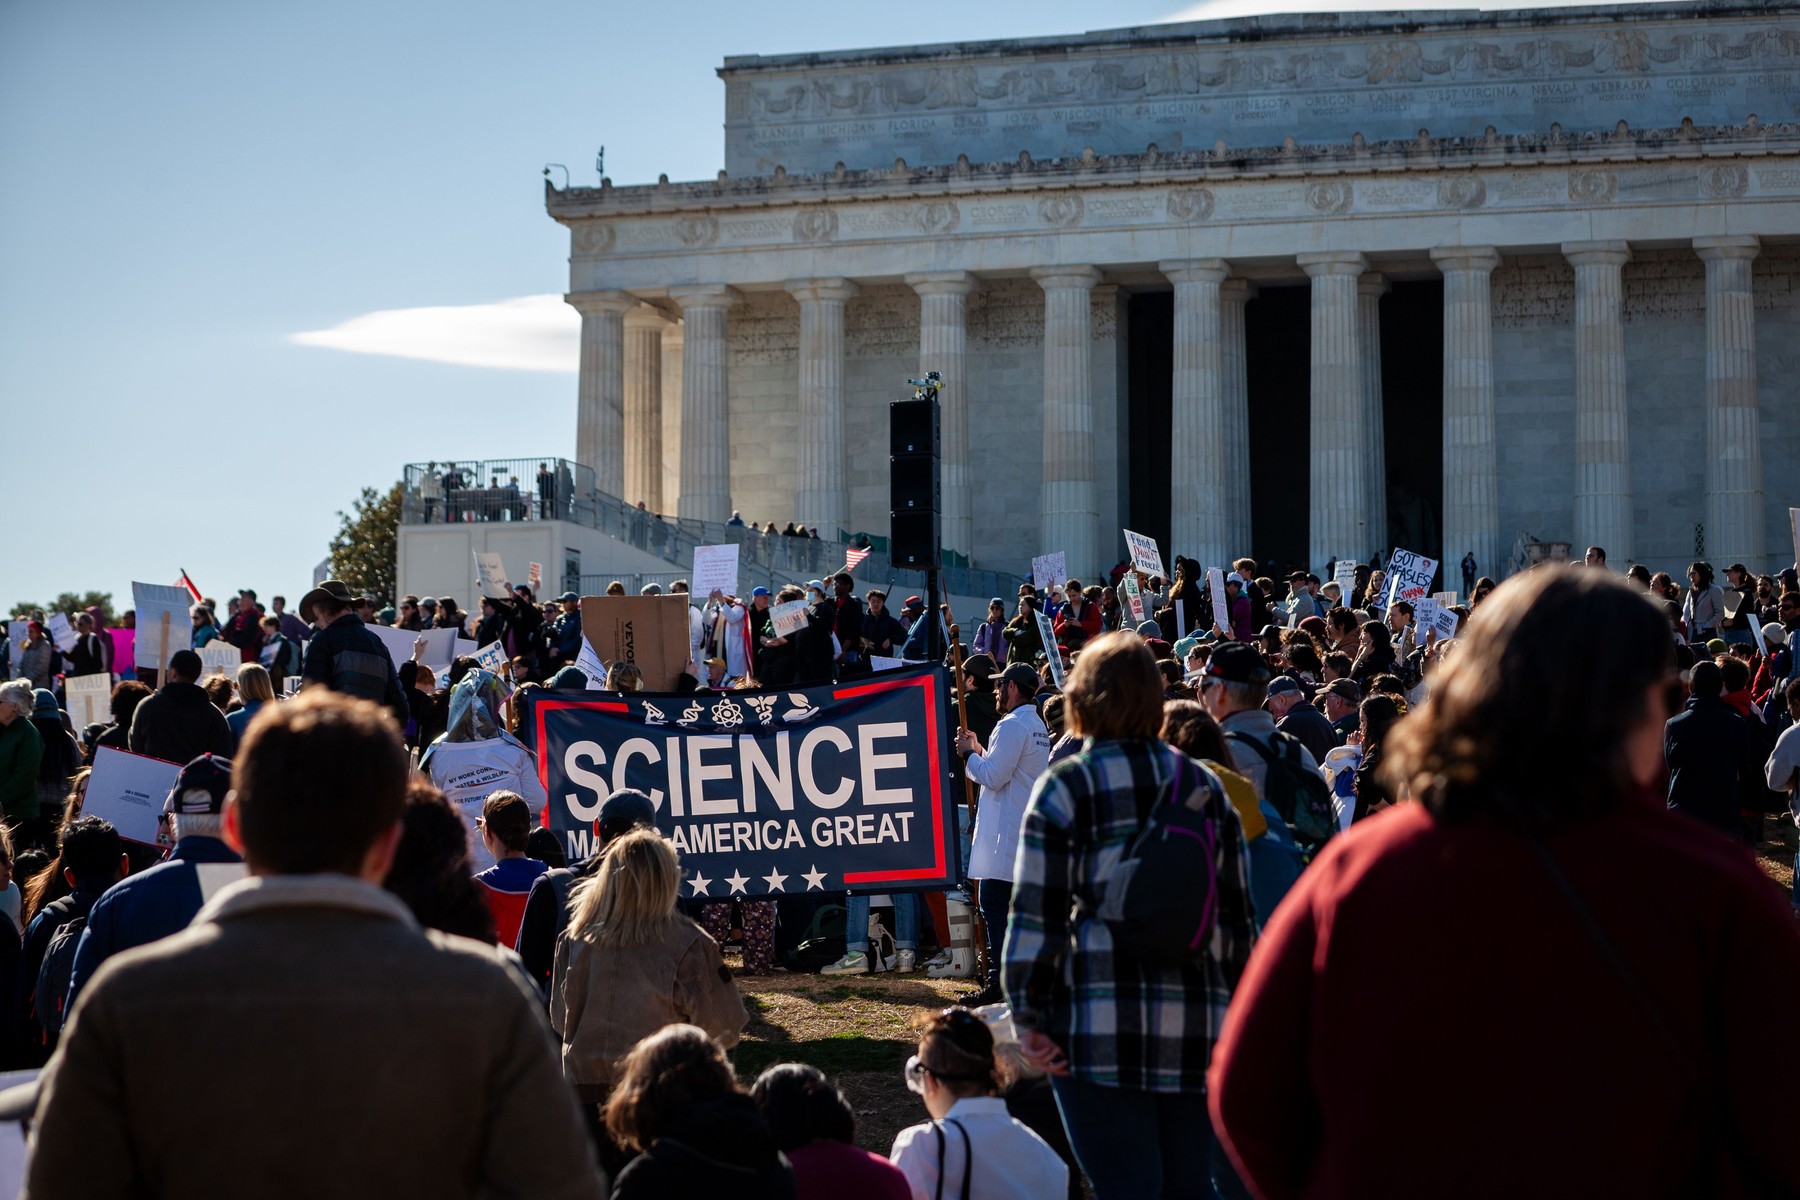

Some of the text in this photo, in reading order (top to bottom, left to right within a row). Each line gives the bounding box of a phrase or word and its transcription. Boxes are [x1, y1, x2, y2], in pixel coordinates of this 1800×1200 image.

[1591, 80, 1652, 93] NEBRASKA
[1666, 77, 1736, 90] COLORADO
[1748, 75, 1792, 86] NORTH
[1426, 86, 1518, 101] WEST VIRGINIA
[1531, 83, 1579, 95] NEVADA
[1305, 94, 1356, 107] OREGON
[1368, 91, 1414, 103] KANSAS
[1135, 102, 1208, 117] CALIFORNIA
[1221, 98, 1292, 111] MINNESOTA
[1005, 112, 1039, 123] IOWA
[1052, 107, 1123, 120] WISCONSIN
[817, 123, 876, 136] MICHIGAN
[888, 119, 937, 131] FLORIDA
[970, 205, 1030, 219] GEORGIA
[1135, 555, 1160, 571] Freeze
[1393, 549, 1420, 567] GOT
[1382, 578, 1406, 594] N?
[1401, 586, 1426, 600] THANK
[458, 770, 475, 781] WORK
[564, 721, 914, 823] SCIENCE
[672, 818, 806, 856] AMERICA
[811, 811, 915, 847] GREAT
